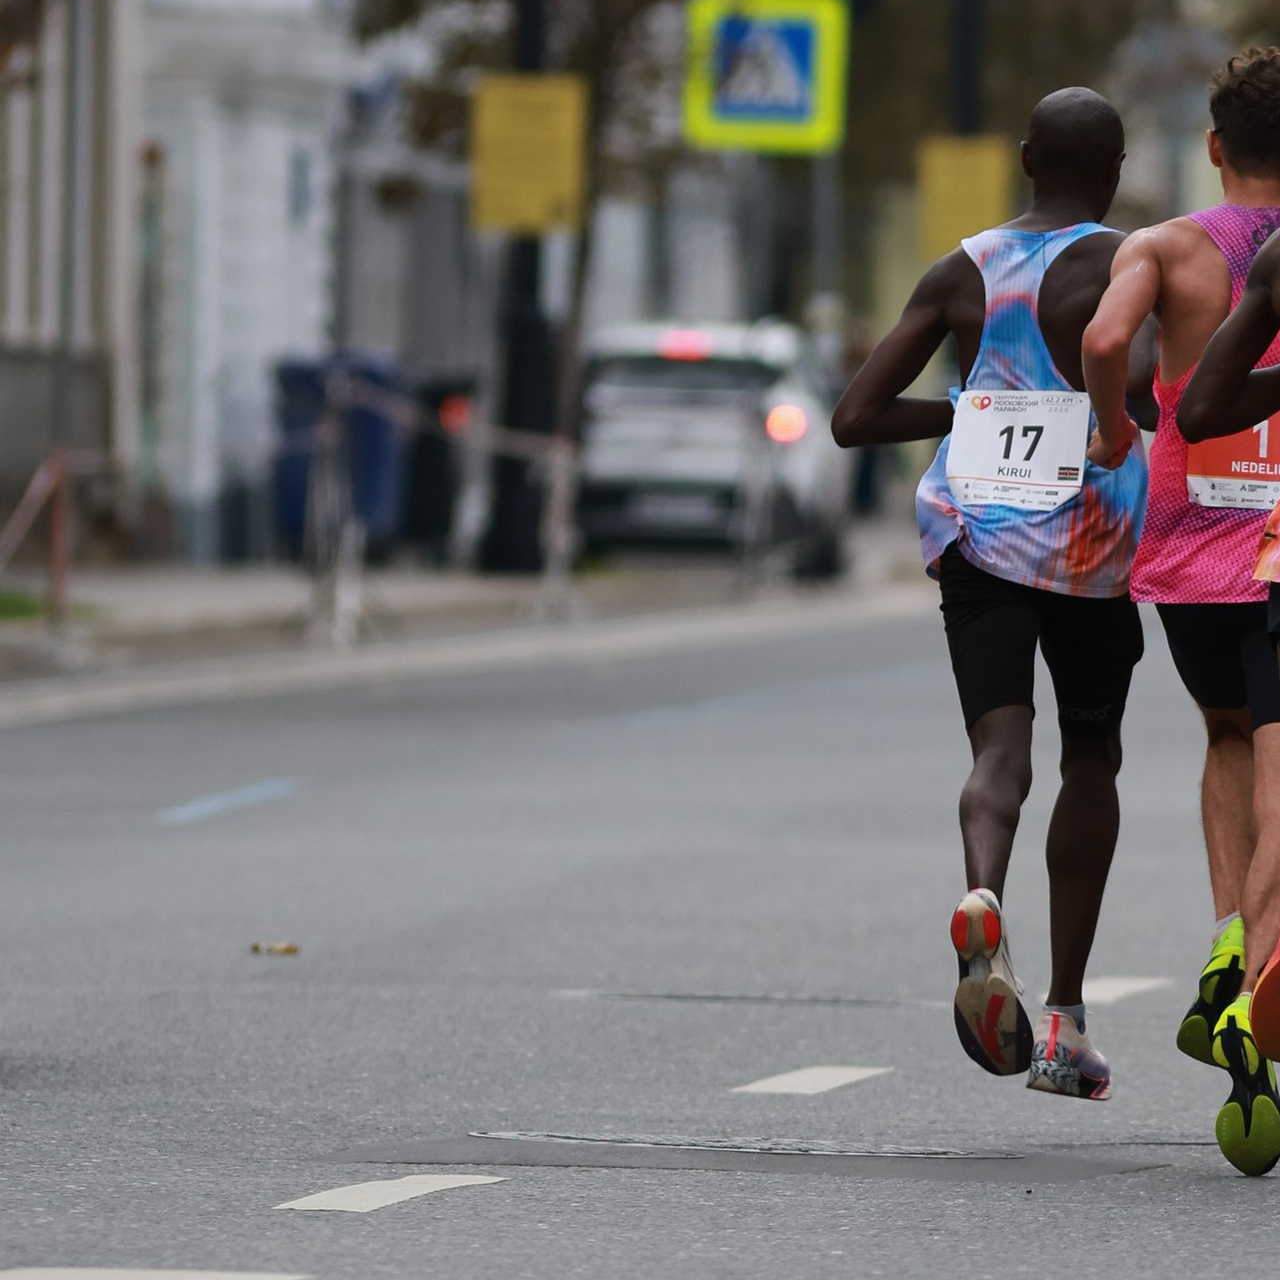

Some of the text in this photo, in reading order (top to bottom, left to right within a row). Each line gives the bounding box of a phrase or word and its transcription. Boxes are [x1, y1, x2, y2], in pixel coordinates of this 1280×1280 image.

[999, 425, 1044, 461] 17
[1253, 420, 1269, 458] 1
[997, 466, 1032, 478] KIRUI
